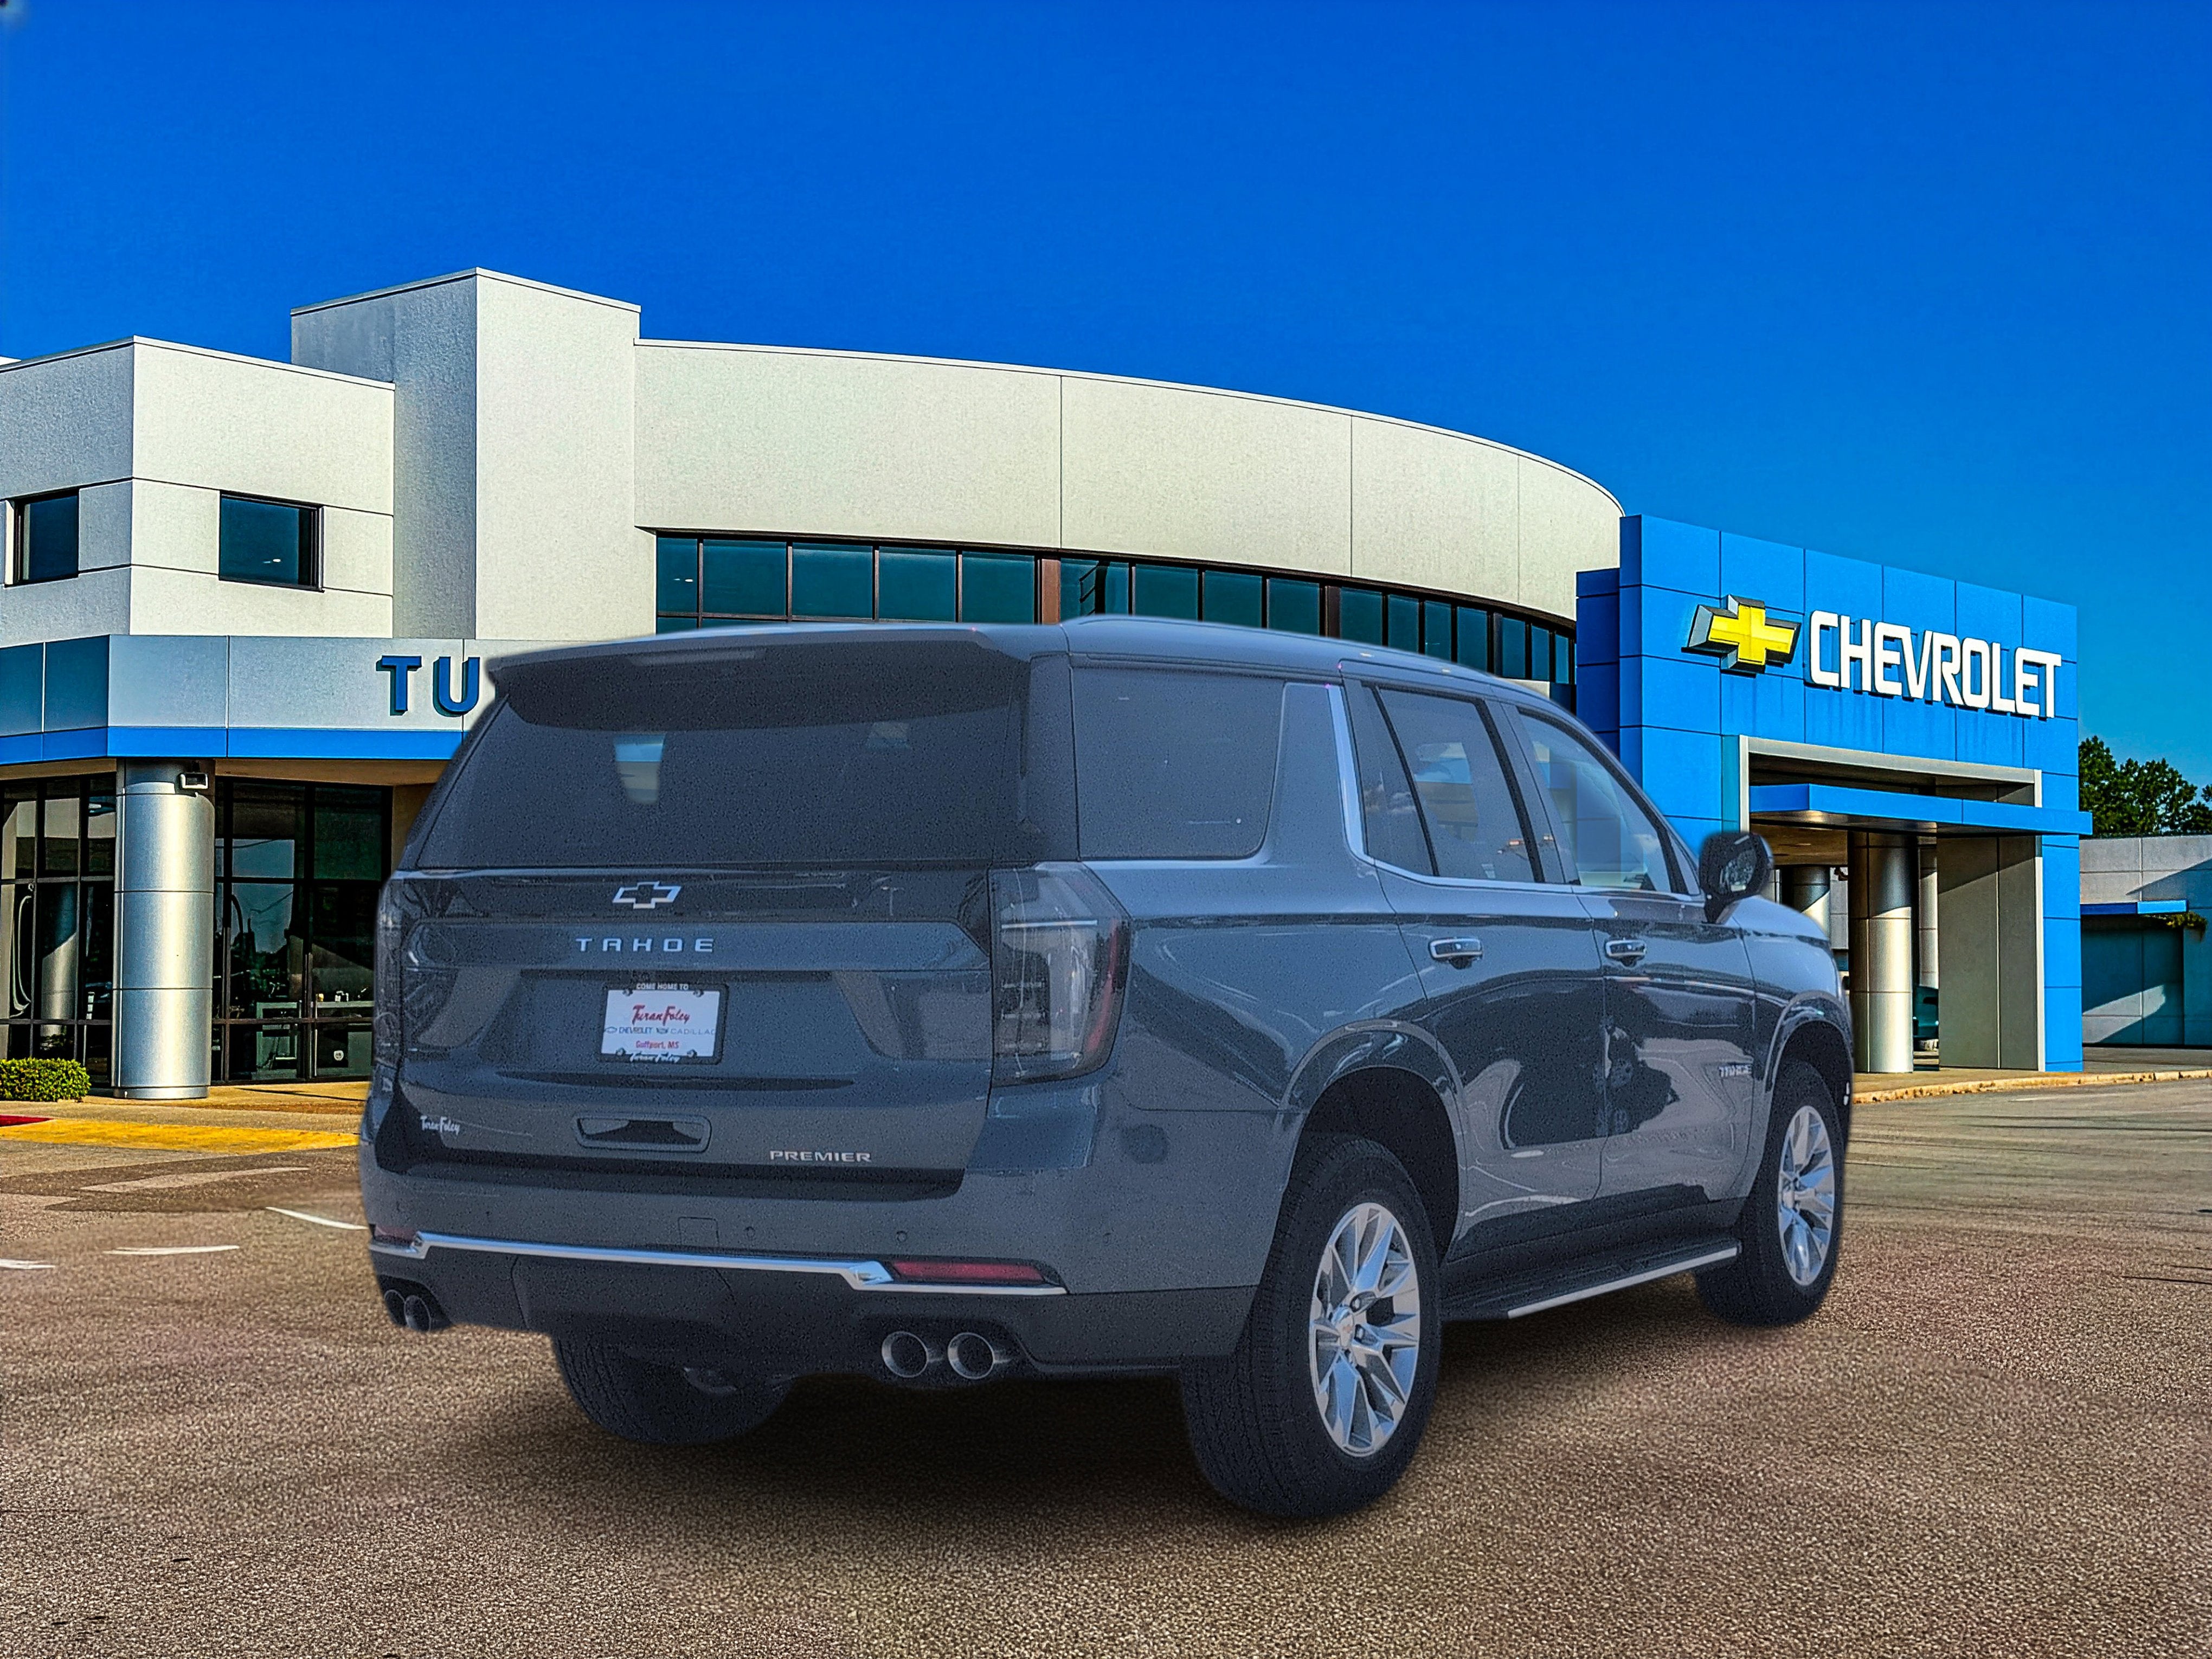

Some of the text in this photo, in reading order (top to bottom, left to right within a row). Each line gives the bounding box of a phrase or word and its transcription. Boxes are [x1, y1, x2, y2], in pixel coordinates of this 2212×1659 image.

[1806, 609, 2062, 720] CHEVROLET
[575, 938, 715, 953] TAHOE
[636, 982, 656, 991] COME
[657, 983, 678, 991] HOME
[667, 1041, 680, 1049] MS
[769, 1150, 871, 1162] PREMIER
